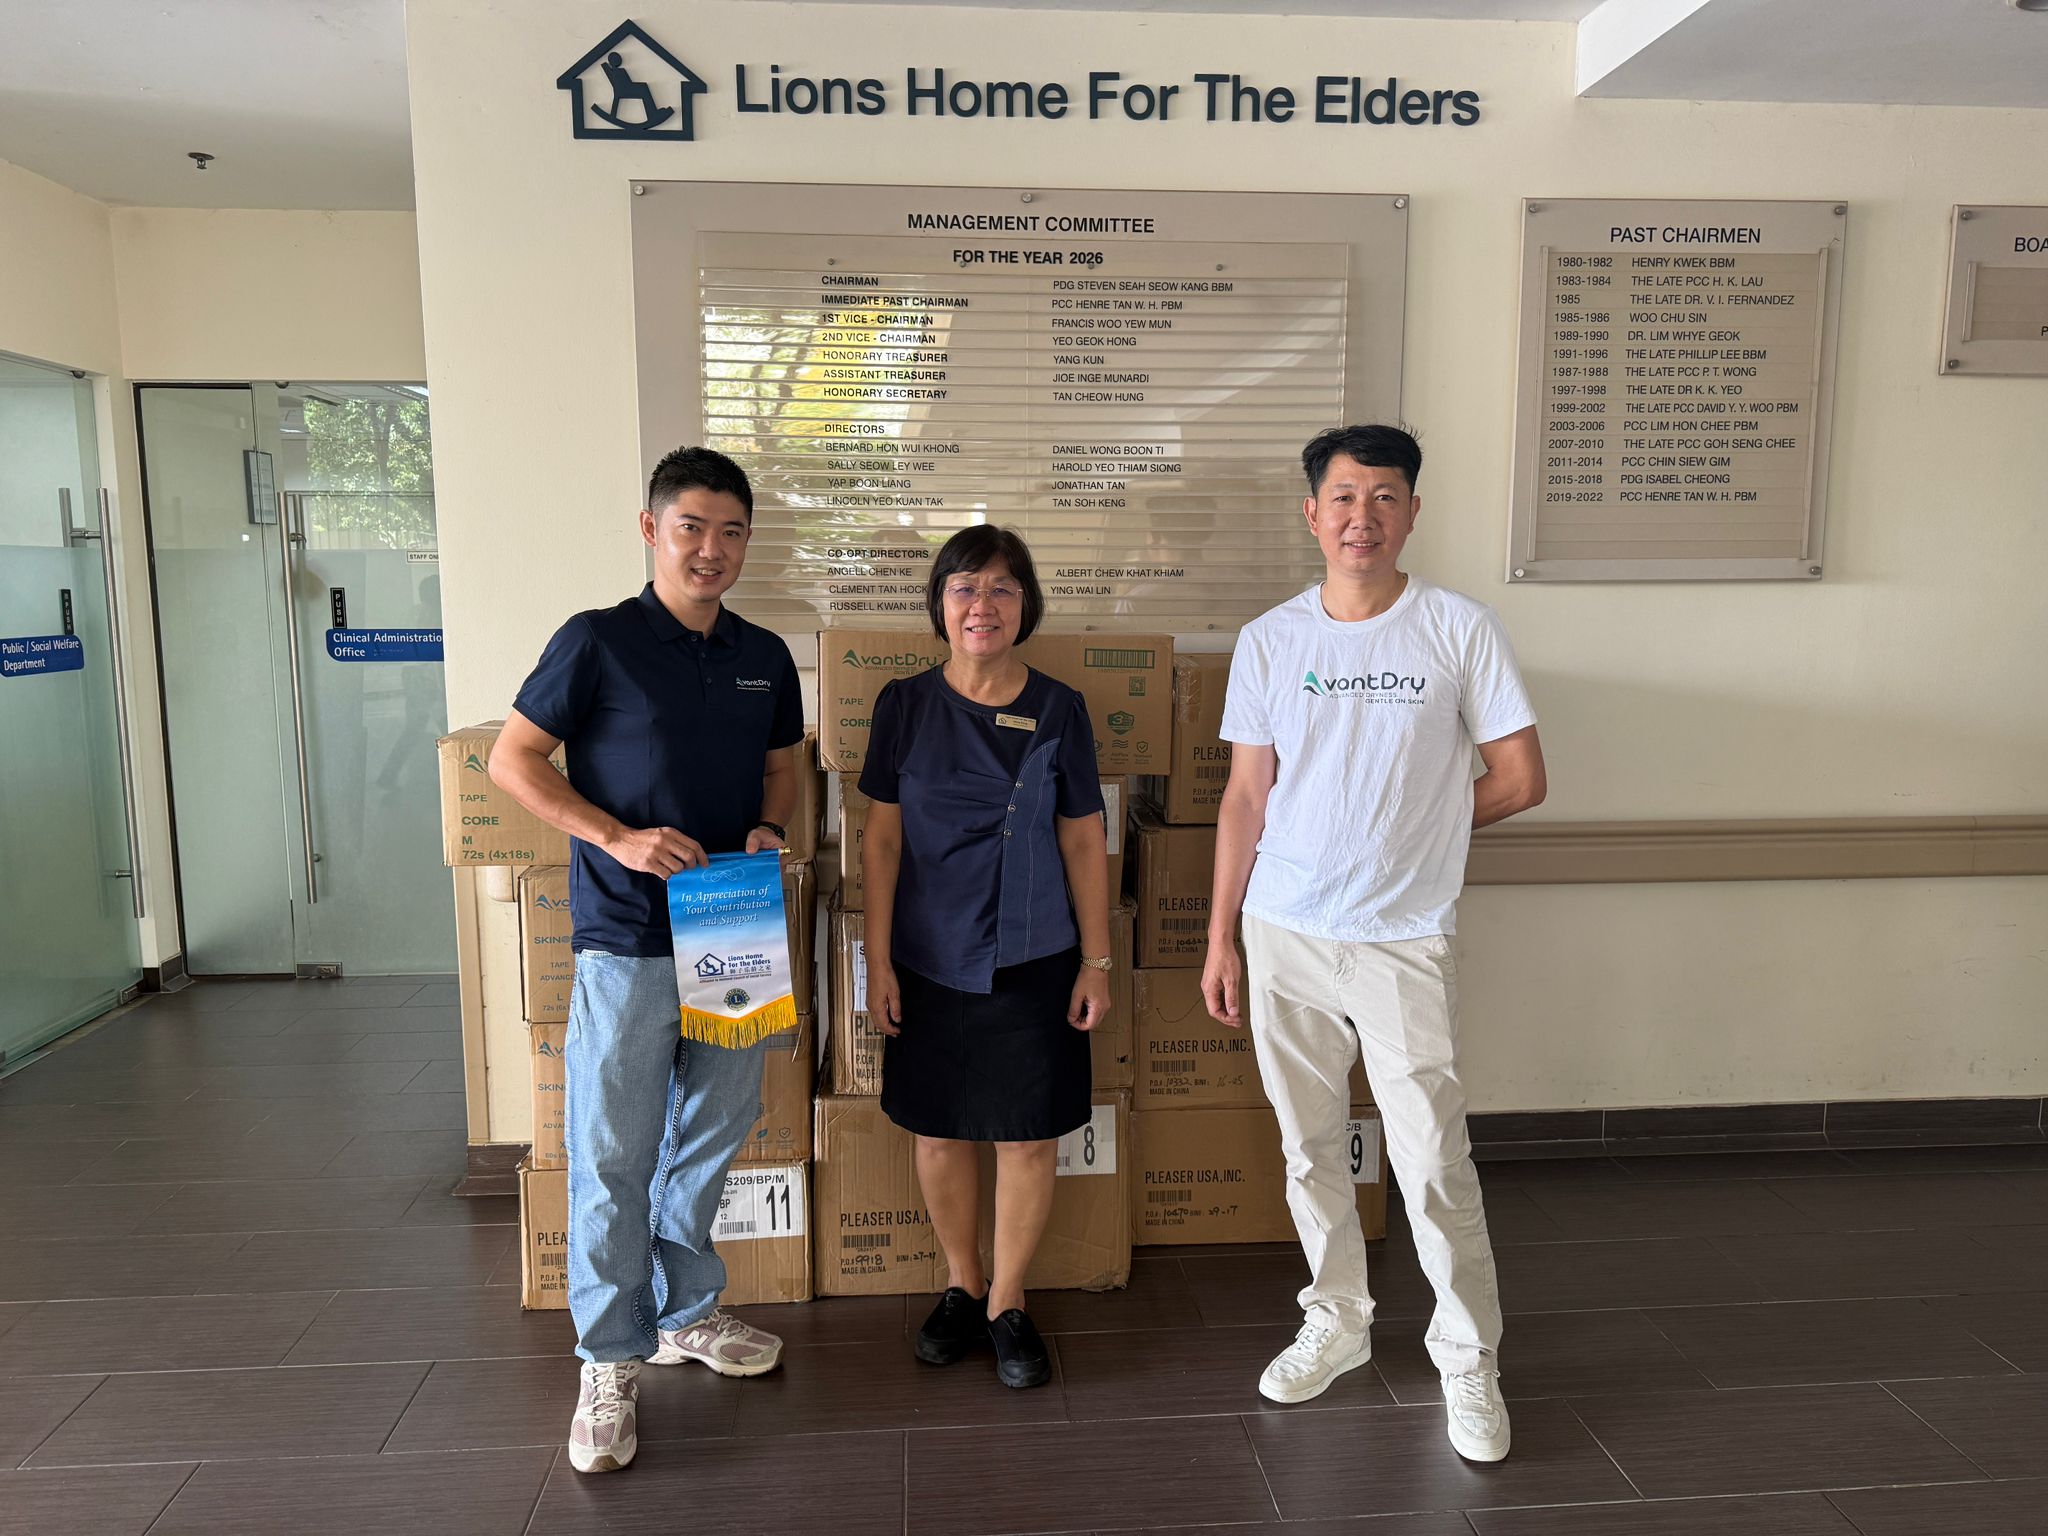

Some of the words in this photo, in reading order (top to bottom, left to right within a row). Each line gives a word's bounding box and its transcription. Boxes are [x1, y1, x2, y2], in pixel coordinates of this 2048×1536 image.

[735, 64, 886, 117] Lions
[906, 68, 1068, 122] Home
[1088, 72, 1180, 123] For
[1194, 74, 1296, 124] The
[1315, 77, 1481, 128] Elders
[908, 215, 1039, 231] MANAGEMENT
[1045, 216, 1155, 233] COMMITTEE
[1610, 228, 1656, 242] PAST
[1663, 228, 1760, 243] CHAIRMEN
[2014, 237, 2048, 252] BOA
[953, 250, 984, 263] FOR
[989, 251, 1018, 264] THE
[1023, 252, 1062, 264] YEAR
[1069, 252, 1103, 265] 2026
[1557, 258, 1612, 267] 1980-1982
[1632, 258, 1671, 268] HENRY
[1673, 258, 1707, 268] KWEK
[1710, 259, 1735, 268] BBM
[821, 276, 878, 286] CHAIRMAN
[1053, 280, 1074, 290] PDG
[1078, 281, 1115, 291] STEVEN
[1119, 281, 1145, 291] SEAH
[1148, 282, 1178, 291] SEOW
[1181, 282, 1208, 292] KANG
[1211, 282, 1233, 292] BBM
[821, 295, 879, 305] IMMEDIATE
[884, 297, 909, 307] PAST
[912, 297, 968, 307] CHAIRMAN
[1052, 318, 1094, 328] FRANCIS
[1097, 319, 1121, 328] WOO
[1123, 319, 1146, 329] YEW
[1148, 319, 1171, 329] MUN
[1555, 313, 1609, 322] 1985-1986
[1630, 313, 1657, 323] WOO
[1661, 314, 1684, 323] CHU
[1688, 314, 1707, 323] SIN
[1553, 331, 1609, 340] 1989-1990
[1628, 331, 1646, 341] DR.
[1650, 331, 1669, 341] LIM
[1672, 332, 1705, 341] WHYE
[1709, 332, 1740, 341] GEOK
[824, 370, 881, 380] ASSISTANT
[885, 371, 946, 381] TREASURER
[824, 388, 883, 398] HONORARY
[886, 389, 947, 399] SECRETARY
[1053, 392, 1072, 401] TAN
[1075, 392, 1113, 402] CHEOW
[1116, 392, 1144, 402] HUNG
[825, 424, 885, 434] DIRECTORS
[1550, 422, 1605, 431] 2003-2006
[1624, 421, 1647, 430] PCC
[1650, 421, 1670, 430] LIM
[1672, 421, 1698, 430] HON
[1700, 421, 1730, 430] CHEE
[1734, 421, 1758, 430] PBM
[1053, 446, 1087, 455] DANIEL
[1089, 446, 1121, 455] WONG
[1123, 446, 1152, 455] BOON
[1155, 446, 1164, 455] TI
[1548, 457, 1603, 467] 2011-2014
[1622, 457, 1645, 466] PCC
[1648, 457, 1675, 466] CHIN
[1679, 457, 1706, 466] SIEW
[1709, 457, 1730, 466] GIM
[1052, 463, 1092, 472] HAROLD
[1095, 463, 1115, 472] YEO
[1118, 463, 1147, 473] THIAM
[1150, 463, 1181, 473] SIONG
[1548, 475, 1602, 484] 2015-2018
[1621, 475, 1643, 484] PDG
[1646, 475, 1681, 484] ISABEL
[1684, 475, 1730, 484] CHEONG
[1052, 481, 1103, 490] JONATHAN
[1106, 481, 1125, 490] TAN
[827, 549, 866, 559] CO-OPT
[870, 549, 929, 559] DIRECTORS
[1056, 568, 1092, 578] ALBERT
[1095, 568, 1124, 578] CHEW
[1126, 568, 1151, 578] KHAT
[1154, 569, 1184, 578] KHIAM
[335, 593, 343, 624] PUSH
[333, 632, 370, 643] Clinical
[374, 632, 442, 643] Administratio
[2, 643, 24, 654] Public
[26, 641, 29, 654] /
[31, 640, 52, 651] Social
[53, 639, 79, 650] Welfare
[334, 647, 365, 657] Office
[4, 658, 45, 673] Department
[840, 719, 872, 727] CORE
[840, 737, 846, 745] L
[839, 750, 858, 758] 72s
[459, 794, 487, 802] TAPE
[462, 816, 499, 825] CORE
[462, 836, 472, 845] M
[462, 850, 485, 859] 72s
[489, 850, 534, 861] (4x18s)
[681, 893, 692, 902] In
[693, 888, 755, 904] Appreciation
[759, 885, 771, 898] of
[683, 905, 707, 915] Your
[710, 900, 771, 913] Contribution
[1159, 898, 1208, 911] PLEASER
[699, 915, 717, 927] and
[719, 913, 759, 927] Support
[557, 993, 563, 1001] L
[1150, 1040, 1198, 1053] PLEASER
[1202, 1039, 1250, 1054] USA,INC.
[1083, 1125, 1095, 1166] 8
[1351, 1133, 1362, 1174] 9
[1145, 1170, 1193, 1184] PLEASER
[1197, 1169, 1245, 1184] USA,INC.
[766, 1185, 791, 1230] 11
[841, 1211, 892, 1227] PLEASER
[538, 1232, 568, 1246] PLEA
